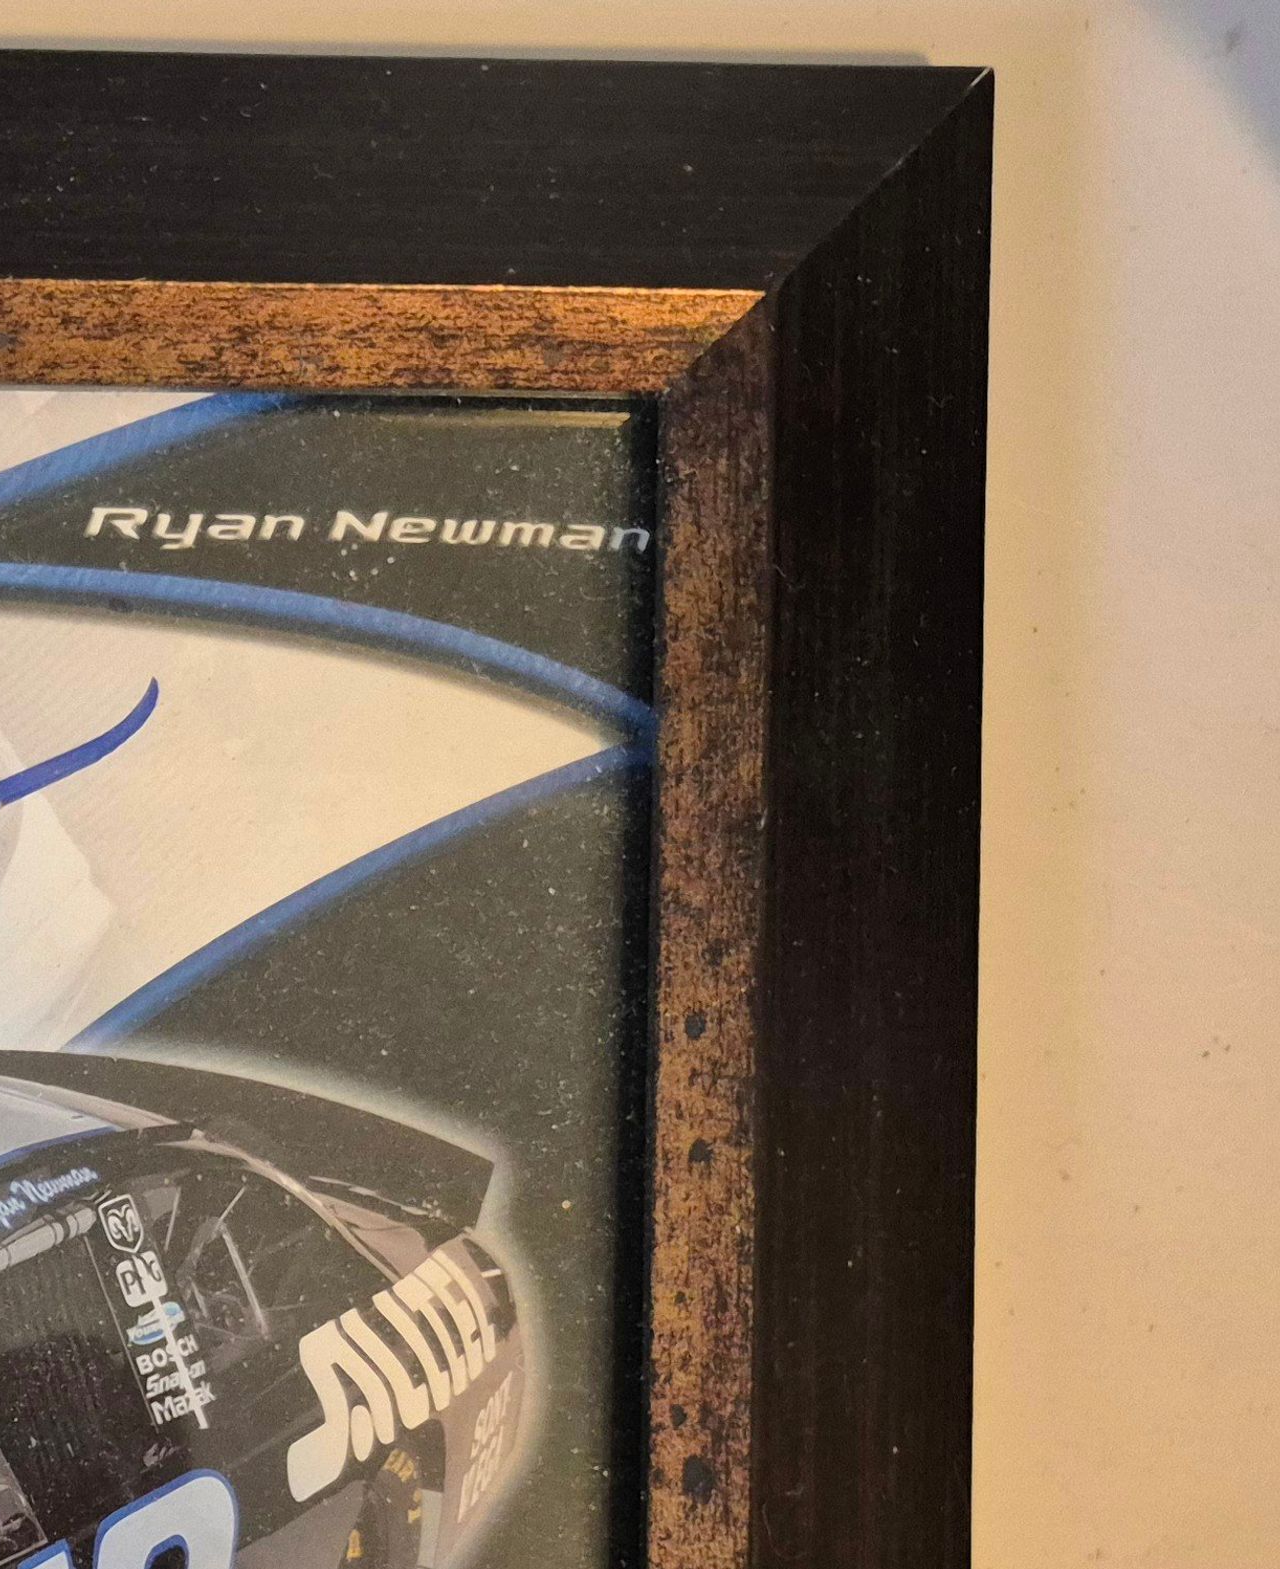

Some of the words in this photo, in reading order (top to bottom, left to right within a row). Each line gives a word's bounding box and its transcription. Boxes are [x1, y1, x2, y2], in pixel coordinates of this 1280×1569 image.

[83, 505, 307, 551] Ryan
[327, 509, 651, 553] Newman
[287, 1249, 497, 1502] ALLTEL
